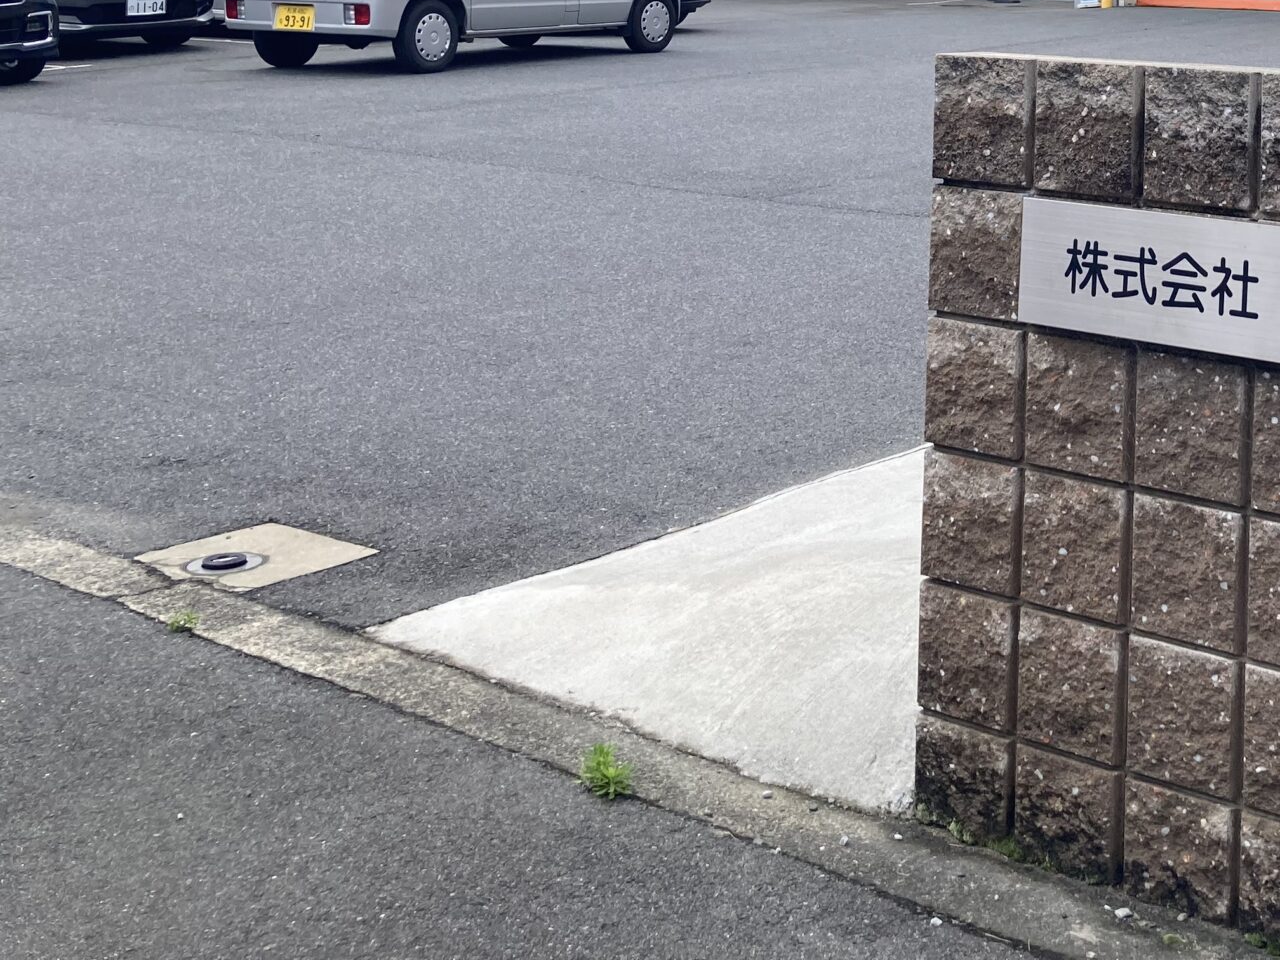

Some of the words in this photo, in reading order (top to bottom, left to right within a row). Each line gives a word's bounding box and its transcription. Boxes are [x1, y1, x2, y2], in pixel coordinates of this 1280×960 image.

[136, 0, 164, 13] 11-04
[284, 14, 311, 28] 93-91
[1064, 238, 1260, 320] 株式会社
